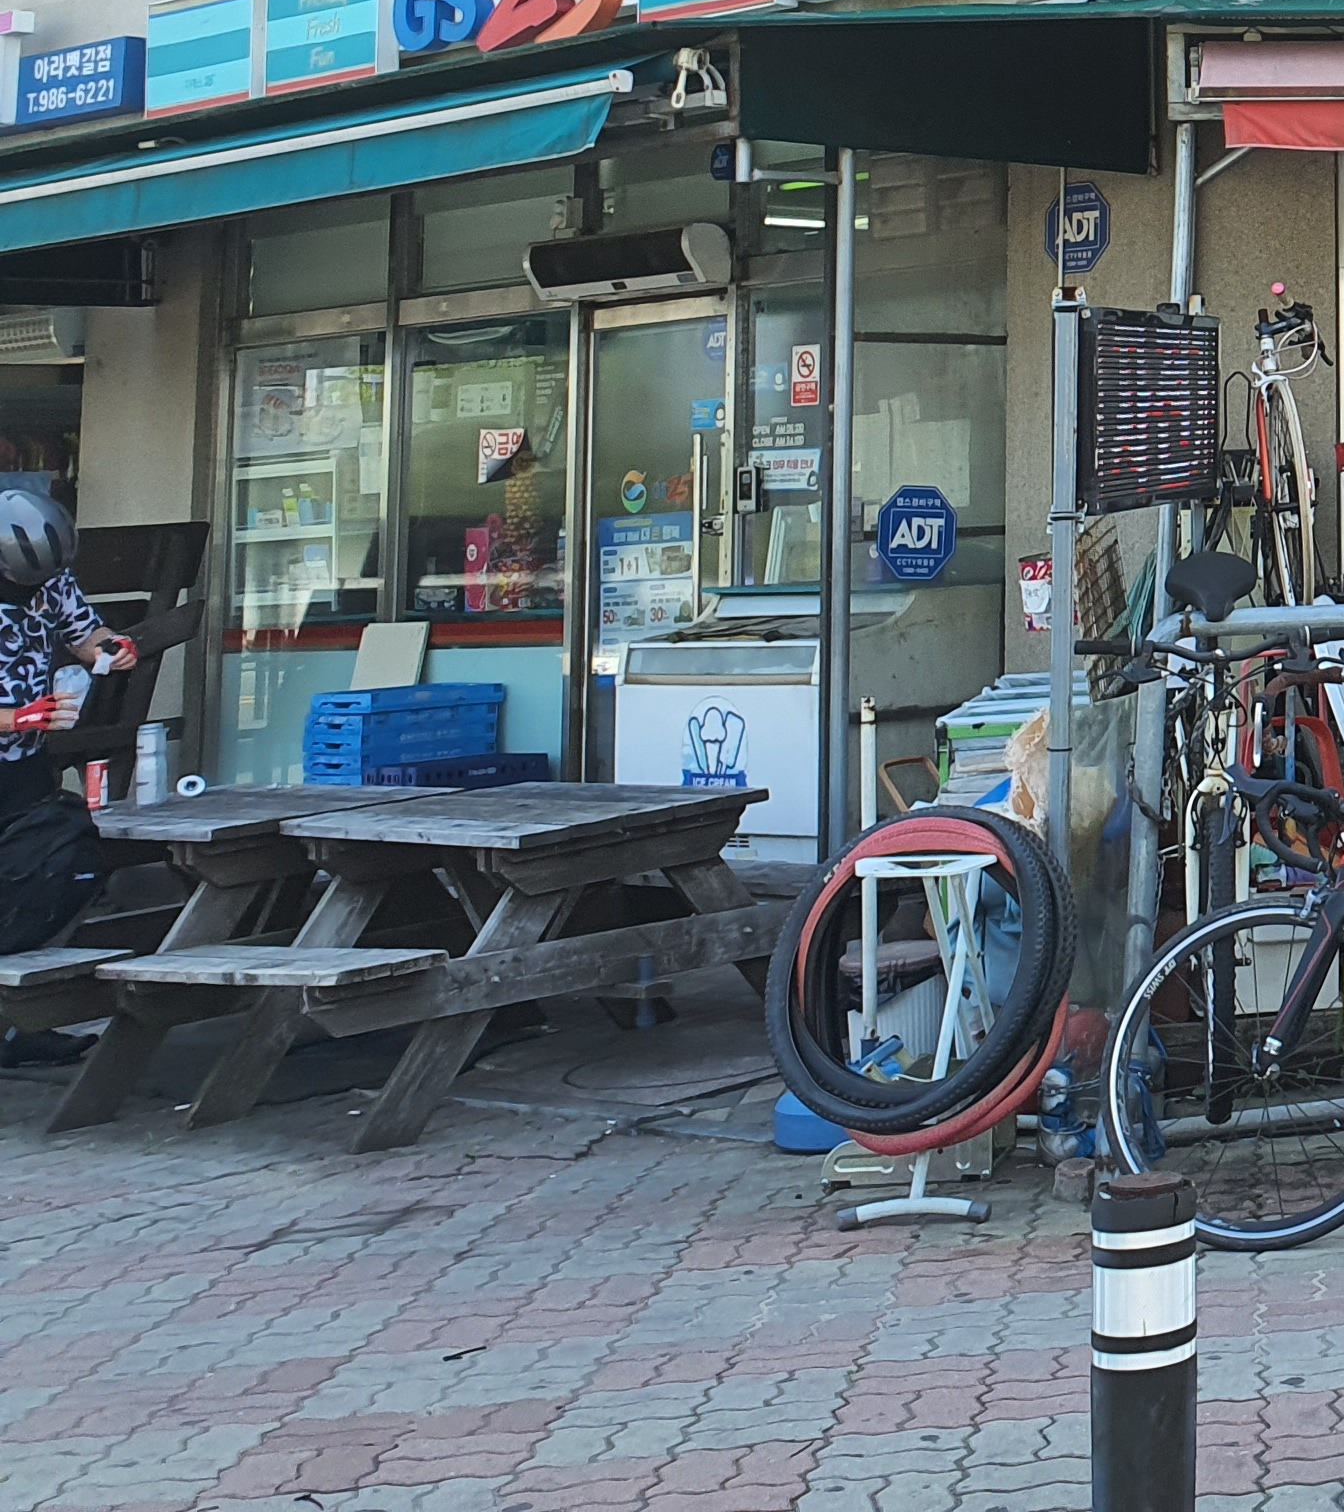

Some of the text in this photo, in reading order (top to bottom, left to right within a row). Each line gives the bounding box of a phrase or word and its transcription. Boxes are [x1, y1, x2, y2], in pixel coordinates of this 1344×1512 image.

[305, 11, 342, 41] Fresh
[33, 43, 113, 85] 아라뱃길점
[309, 46, 336, 70] Fun
[26, 78, 115, 115] T.986-6221
[1055, 210, 1100, 243] ADT
[706, 331, 727, 349] ADT
[889, 516, 945, 550] ADT
[619, 556, 641, 576] 1+1
[692, 777, 737, 787] ICE CREAM
[1143, 958, 1177, 1000] DT SWISS
